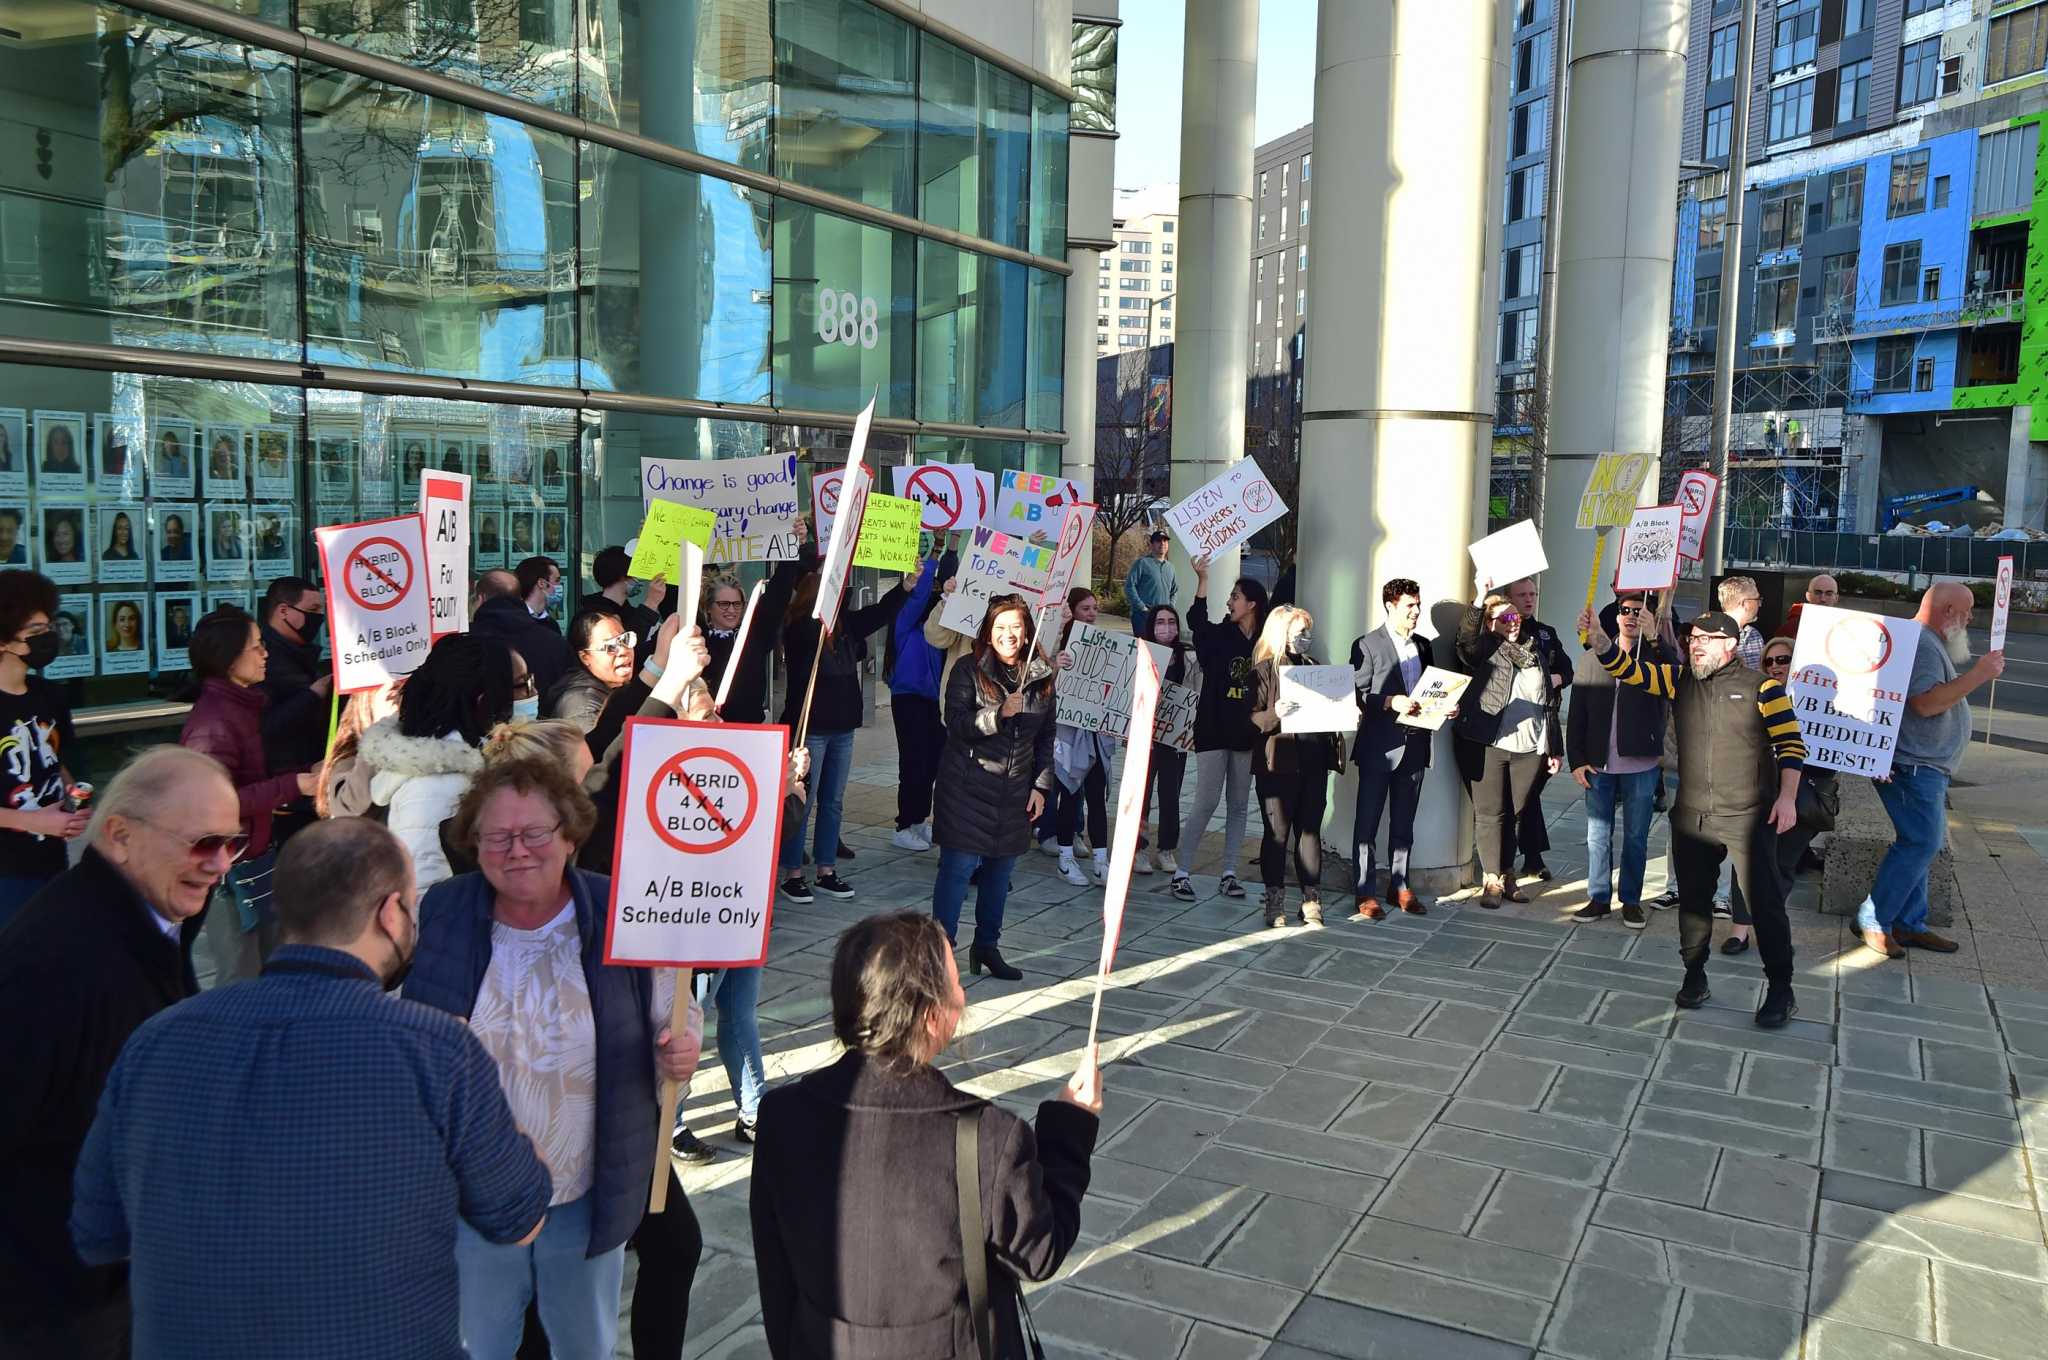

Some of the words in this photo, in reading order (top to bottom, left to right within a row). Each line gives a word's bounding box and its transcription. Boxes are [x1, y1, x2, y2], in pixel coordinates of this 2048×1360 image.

[818, 288, 878, 350] 888
[647, 464, 715, 500] Change
[723, 473, 737, 489] is
[747, 454, 797, 493] good!
[1002, 469, 1057, 496] KEEP
[1588, 452, 1649, 494] NO
[748, 498, 797, 521] change
[1173, 483, 1224, 527] LISTEN
[1230, 472, 1242, 483] TO
[1579, 492, 1638, 528] HYBRID
[437, 509, 457, 543] A/B
[862, 519, 887, 529] DENTS
[890, 519, 907, 530] WANT
[1189, 504, 1234, 541] TEACHERS
[1635, 520, 1648, 528] A/B
[1650, 519, 1670, 527] Block
[882, 534, 902, 545] WANT
[974, 525, 1009, 556] WE
[1199, 515, 1247, 558] STUDENTS
[354, 551, 400, 569] HYBRID
[856, 546, 873, 561] A/B
[366, 573, 373, 582] 4
[386, 568, 394, 578] 4
[440, 563, 454, 585] For
[361, 582, 402, 599] BLOCK
[960, 613, 984, 630] A/
[356, 627, 383, 649] A/B
[386, 622, 418, 640] Block
[1080, 624, 1118, 650] Listen
[343, 642, 402, 666] Schedule
[405, 637, 429, 653] Only
[1064, 640, 1137, 689] STUDEN
[1057, 673, 1112, 706] VOICES!
[1431, 681, 1443, 690] NO
[1099, 712, 1132, 735] AIT
[1156, 703, 1186, 722] HAT
[1793, 695, 1818, 713] /B
[1824, 700, 1894, 727] BCK
[1800, 720, 1893, 751] HEDULE
[1817, 747, 1877, 772] BEST!
[668, 773, 740, 789] HYBRID
[680, 795, 690, 808] 4
[714, 796, 724, 809] 4
[667, 817, 733, 832] BLOCK
[645, 875, 684, 903] A/B
[691, 881, 744, 899] Block
[622, 906, 711, 925] Schedule
[718, 908, 761, 928] Only
